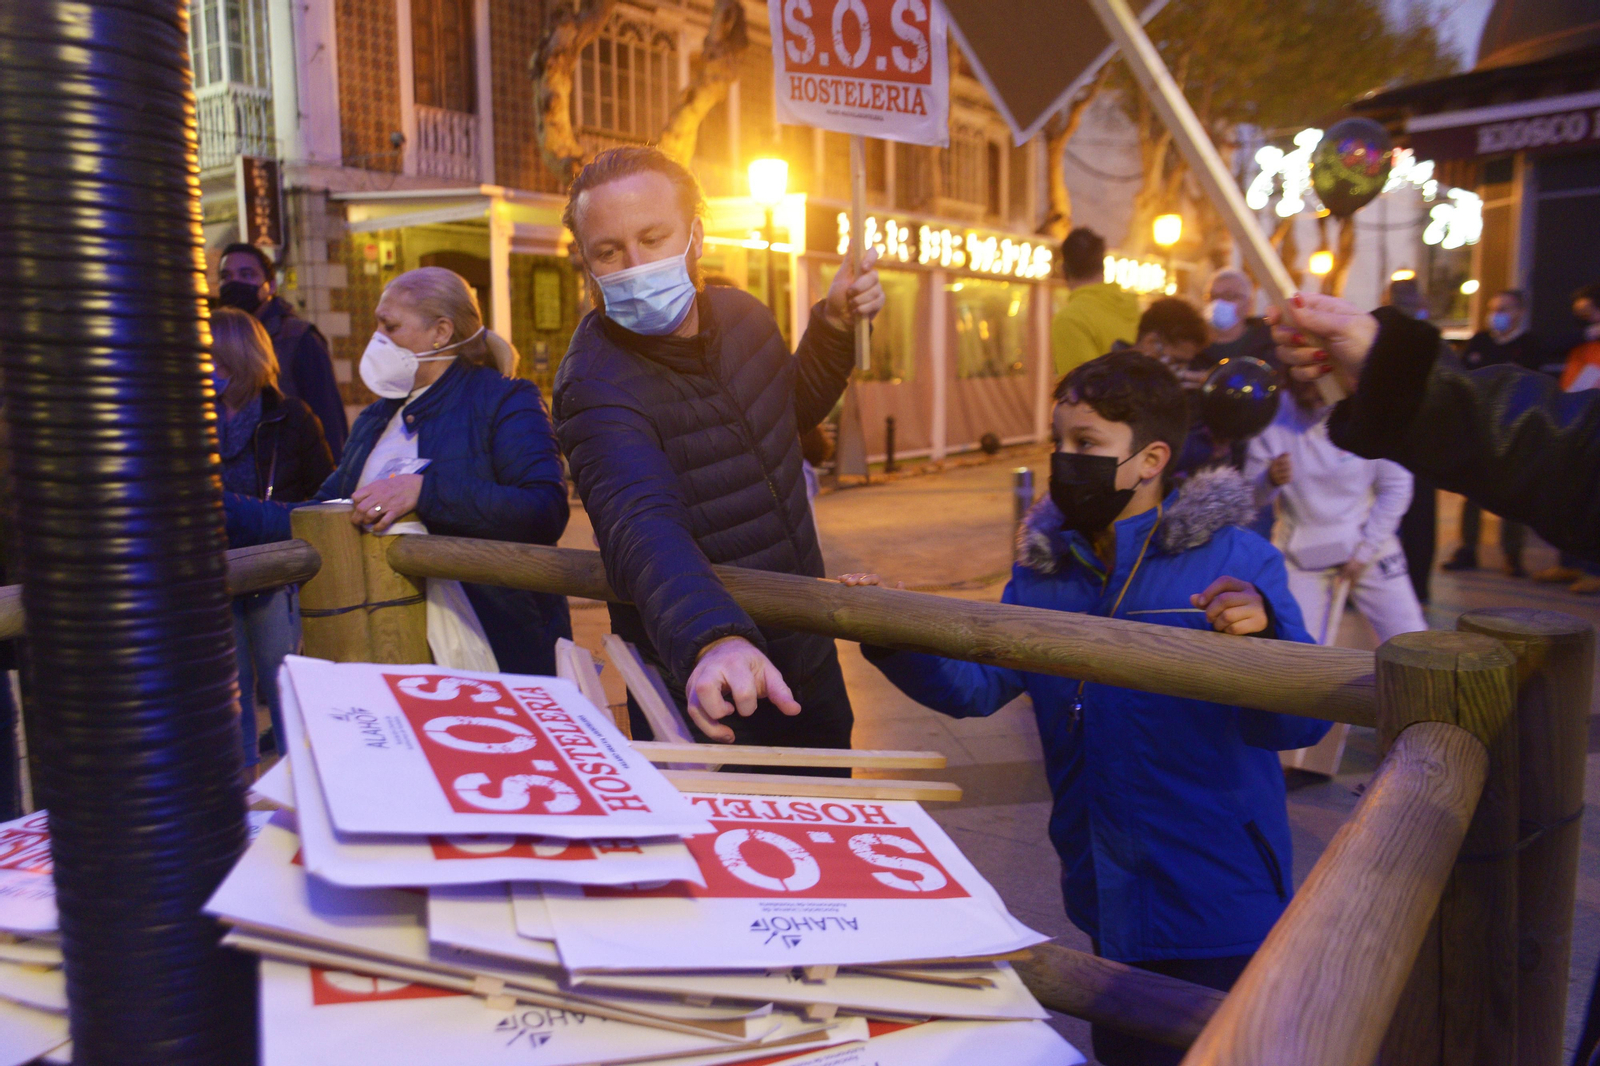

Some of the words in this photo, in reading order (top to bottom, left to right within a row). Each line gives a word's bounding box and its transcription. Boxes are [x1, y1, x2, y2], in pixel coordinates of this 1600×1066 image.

[784, 0, 929, 73] S.O.S
[789, 75, 928, 116] HOSTELERIA
[396, 676, 581, 813] S.O.S
[513, 686, 652, 814] HOSTELERIA
[690, 797, 897, 825] HOSTEL
[713, 828, 948, 892] S.O
